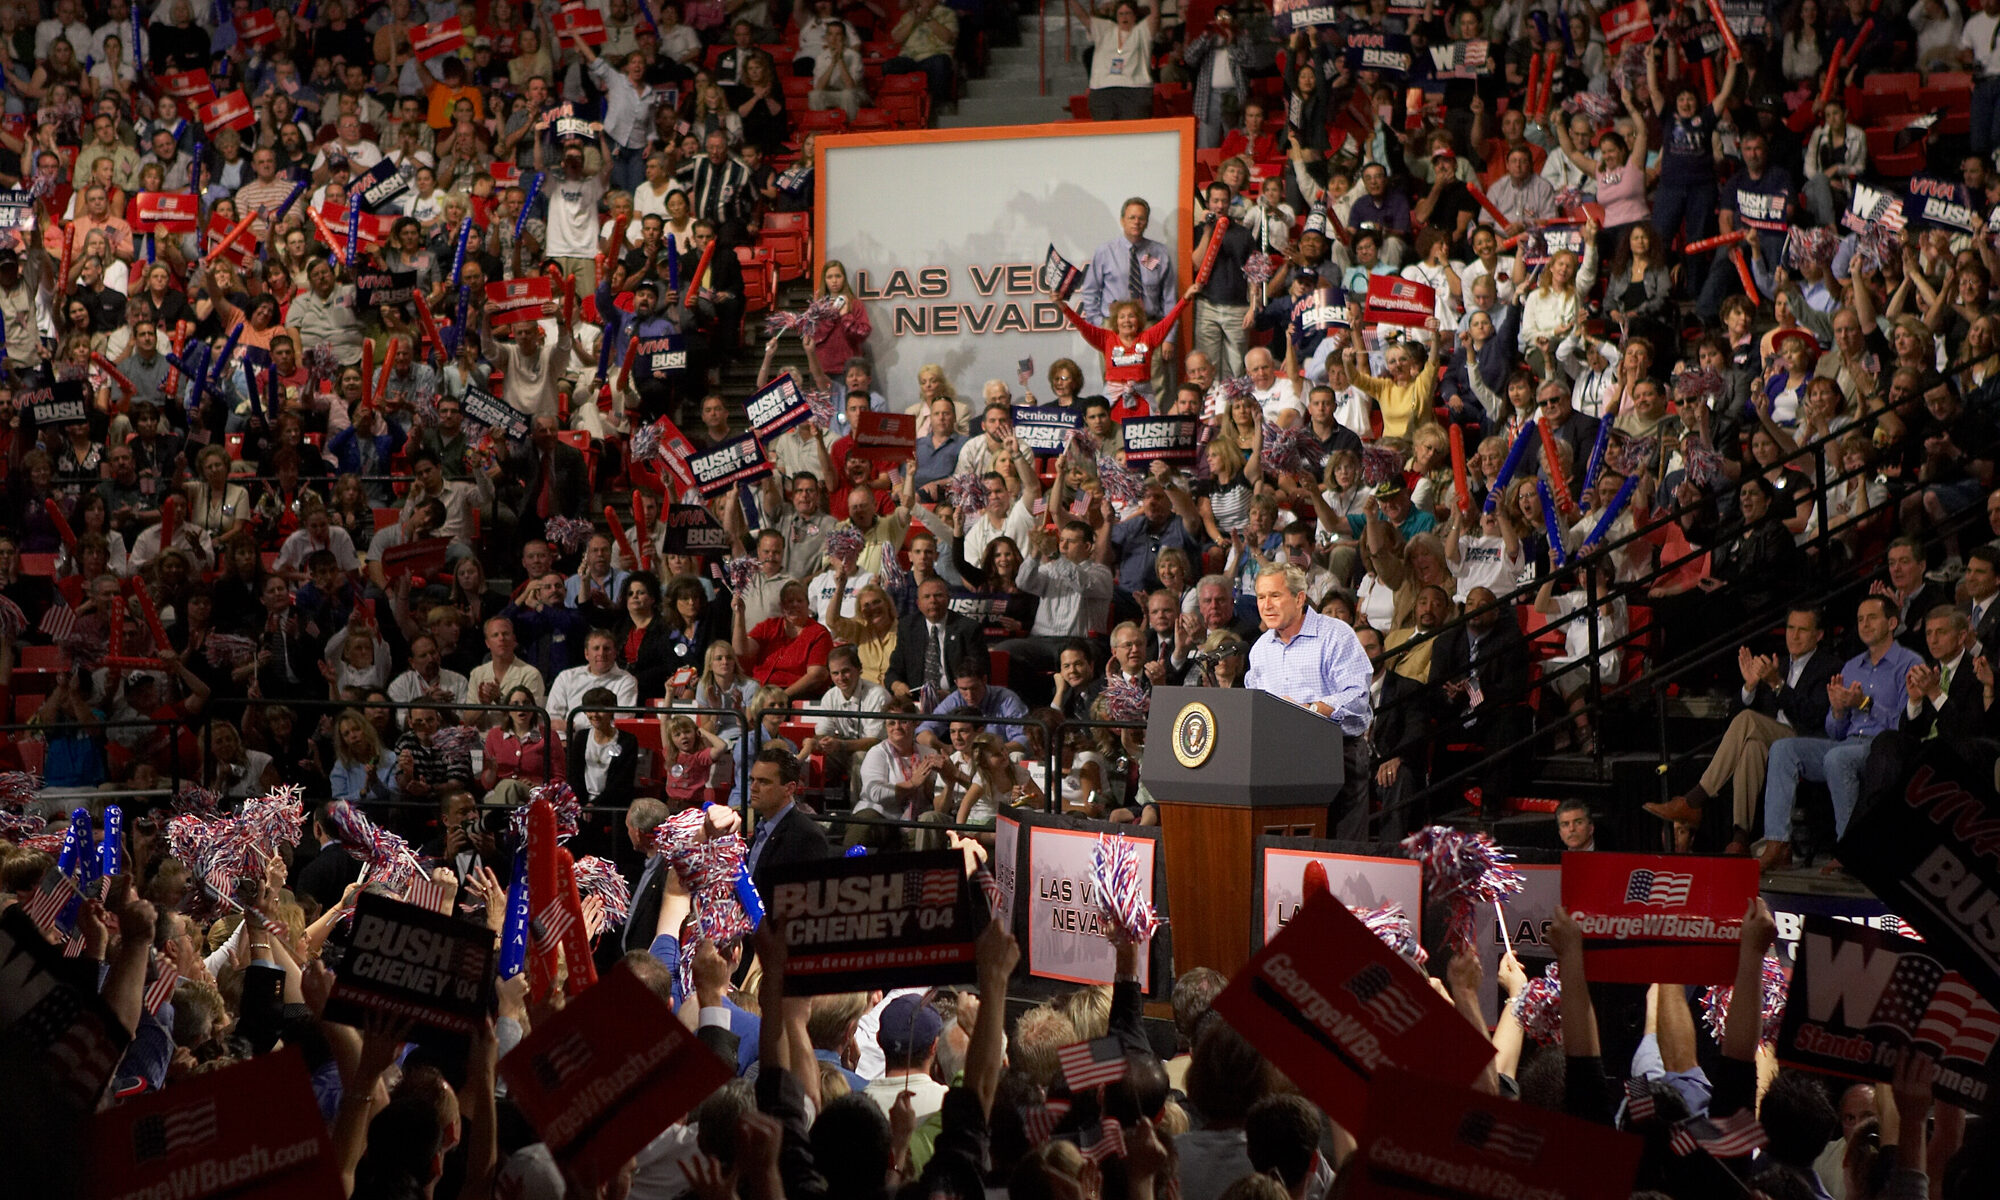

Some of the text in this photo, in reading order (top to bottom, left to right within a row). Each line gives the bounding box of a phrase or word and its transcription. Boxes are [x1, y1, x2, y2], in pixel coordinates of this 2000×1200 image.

[1291, 7, 1335, 24] BUSH
[1347, 34, 1385, 49] VIVA
[1428, 44, 1454, 71] W
[364, 173, 406, 205] BUSH
[1852, 181, 1882, 220] W
[1911, 177, 1954, 202] VIVA
[857, 266, 950, 300] LAS
[1302, 306, 1350, 327] BUSH
[637, 338, 670, 356] VIVA
[651, 352, 686, 368] BUSH
[13, 387, 54, 409] VIVA
[33, 401, 84, 421] BUSH
[746, 385, 782, 420] BUSH
[753, 393, 798, 428] CHENEY '04
[1014, 410, 1075, 423] Seniors for
[1013, 425, 1059, 440] BUSH
[1124, 422, 1176, 440] BUSH
[1128, 439, 1176, 451] CHENEY
[691, 446, 738, 474] BUSH
[699, 452, 758, 482] CHENEY '04
[670, 510, 707, 528] VIVA
[947, 598, 986, 613] USH
[774, 872, 904, 919] BUSH
[1039, 877, 1073, 903] LAS
[784, 908, 955, 946] CHENEY '04
[353, 915, 455, 972] BUSH
[351, 955, 479, 1003] CHENEY '04
[1804, 931, 1901, 1031] W
[1794, 1023, 1874, 1063] Stands
[1875, 1041, 1899, 1069] fo
